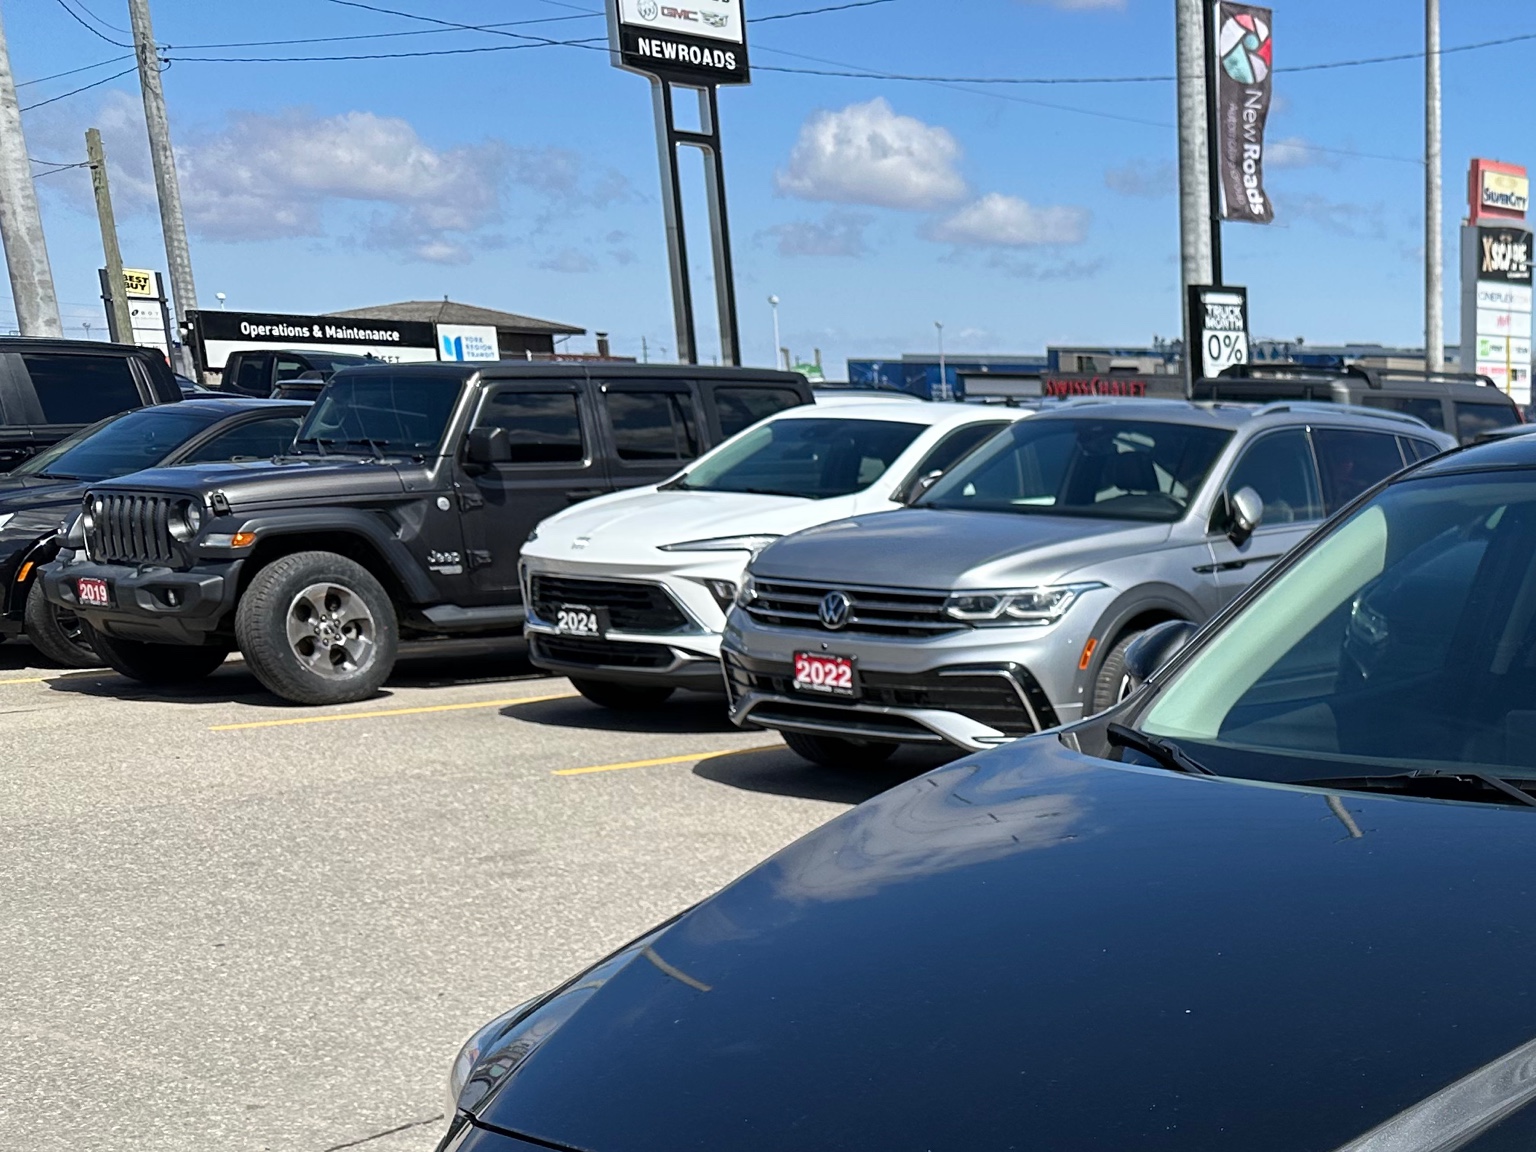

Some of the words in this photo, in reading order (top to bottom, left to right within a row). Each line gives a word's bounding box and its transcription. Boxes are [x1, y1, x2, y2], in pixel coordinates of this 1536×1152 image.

[661, 6, 699, 22] GMC
[637, 37, 737, 70] NEWROADS
[240, 321, 309, 338] Operations
[312, 324, 323, 338] &
[325, 325, 400, 341] Maintenance
[1208, 334, 1243, 363] 0%
[80, 584, 107, 602] 2019
[557, 611, 598, 632] 2024
[796, 660, 852, 688] 2022
